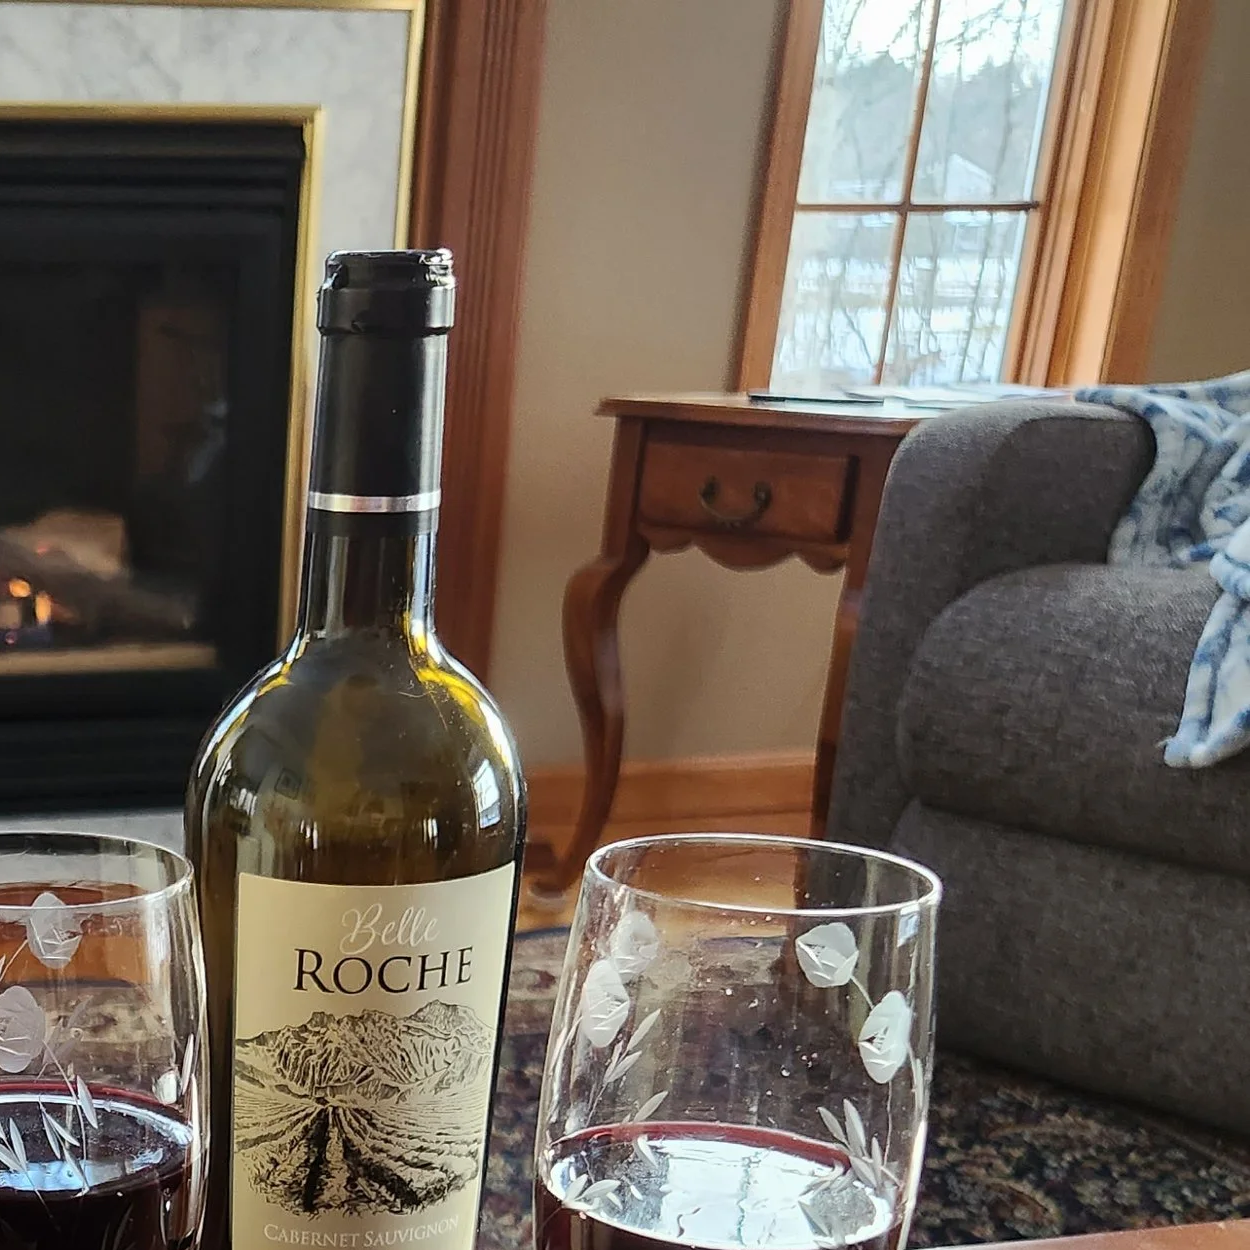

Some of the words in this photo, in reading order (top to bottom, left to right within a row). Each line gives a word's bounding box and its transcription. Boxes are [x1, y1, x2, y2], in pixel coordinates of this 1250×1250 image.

[340, 903, 438, 954] Belle
[293, 947, 473, 994] ROCHE
[264, 1223, 359, 1248] CABERNET
[364, 1215, 459, 1247] SAUVIGNON
